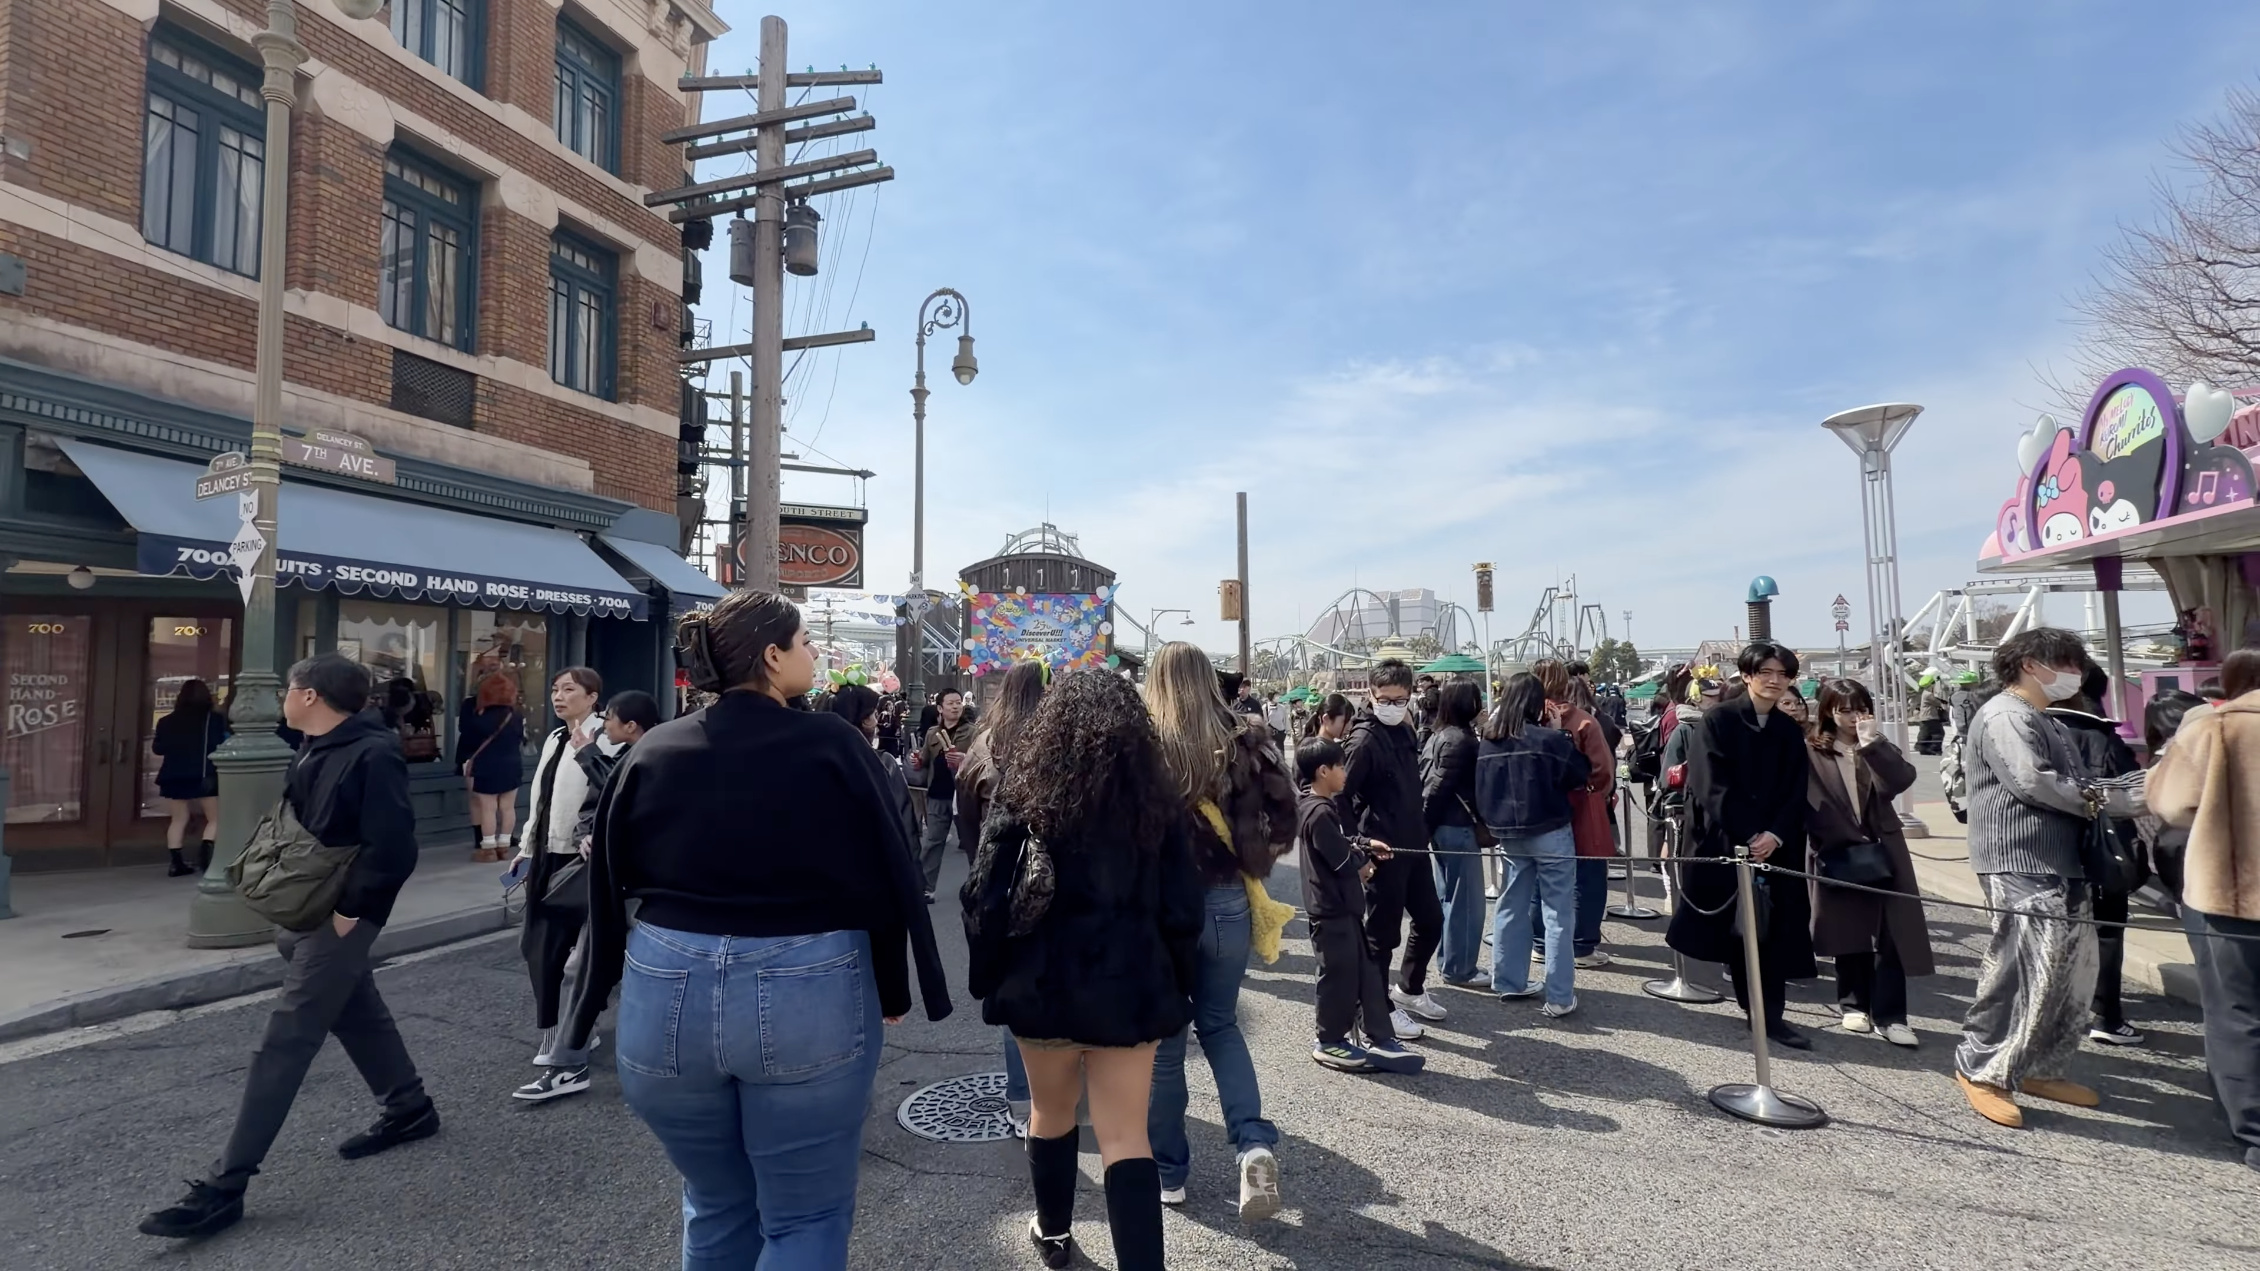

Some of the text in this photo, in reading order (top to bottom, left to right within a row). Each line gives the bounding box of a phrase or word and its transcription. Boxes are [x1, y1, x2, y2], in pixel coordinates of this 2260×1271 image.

[316, 432, 352, 447] DELANCEY
[2106, 405, 2156, 460] Churritos
[339, 454, 379, 476] AVE.
[197, 474, 242, 496] DELANCEY
[243, 503, 254, 514] NO
[811, 509, 854, 518] STREET
[232, 539, 262, 554] PARKING
[779, 542, 848, 565] ENCO
[276, 559, 322, 576] UITS
[335, 565, 417, 588] SECOND
[427, 575, 478, 594] HAND
[486, 583, 529, 599] ROSE
[536, 590, 592, 605] DRESSES
[599, 596, 631, 610] 700A
[28, 623, 65, 635] 700
[174, 626, 208, 636] 700
[10, 673, 68, 686] SECOND
